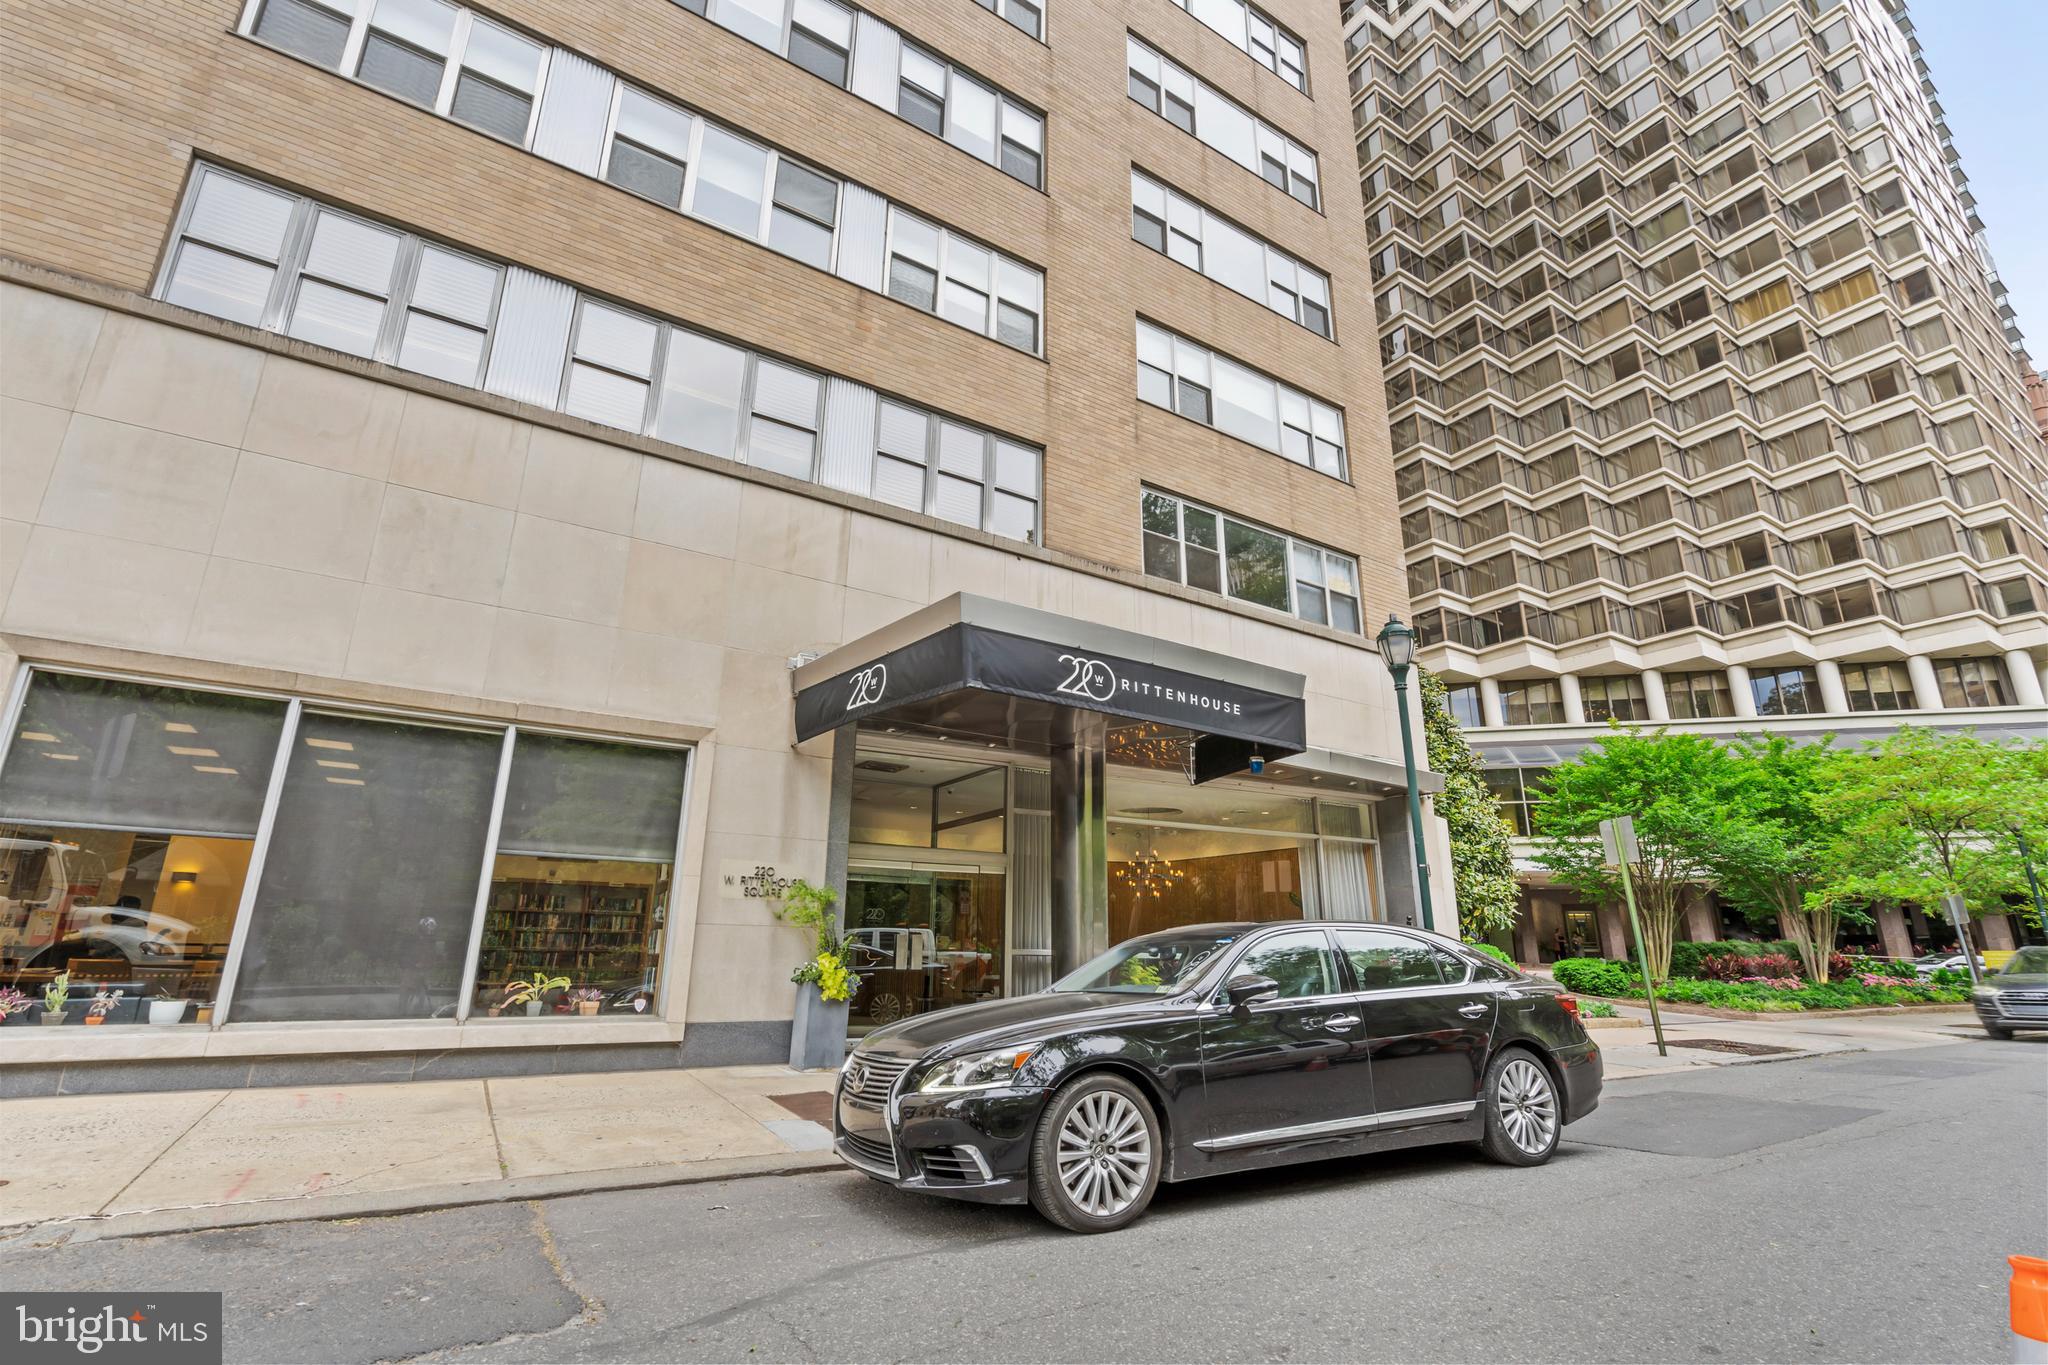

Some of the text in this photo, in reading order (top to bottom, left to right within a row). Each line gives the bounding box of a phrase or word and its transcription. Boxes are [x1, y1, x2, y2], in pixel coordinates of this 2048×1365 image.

[846, 663, 887, 710] 220
[1056, 654, 1241, 715] 220 RITTENHOUSE
[754, 866, 775, 877] 220
[743, 886, 782, 898] SQUARE
